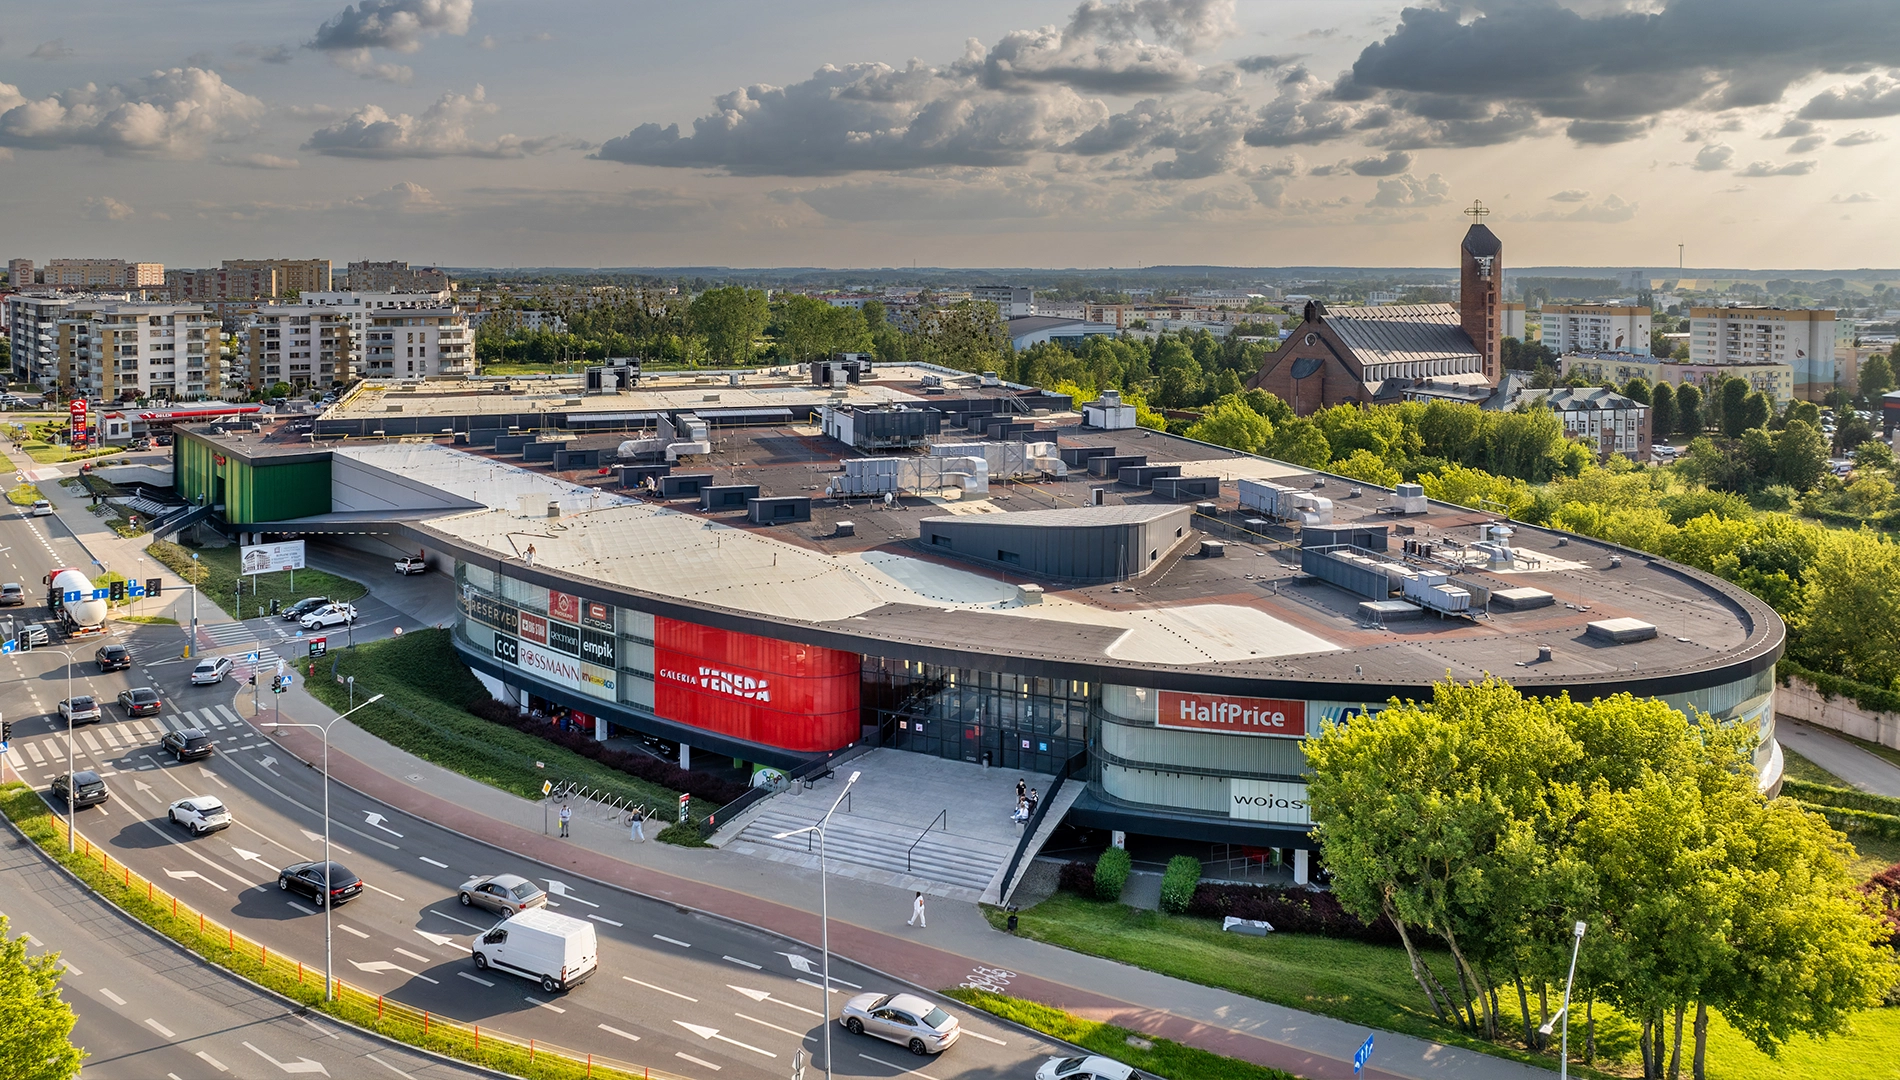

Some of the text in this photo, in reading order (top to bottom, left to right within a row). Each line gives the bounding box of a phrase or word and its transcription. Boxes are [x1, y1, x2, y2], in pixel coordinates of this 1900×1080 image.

[584, 617, 614, 630] cropp
[497, 640, 516, 658] CCC
[583, 641, 615, 659] empik
[520, 648, 580, 682] ROSSMANN
[660, 666, 771, 702] GALERIA VENEDA
[1180, 699, 1285, 727] HalfPrice
[1234, 793, 1304, 810] wojas
